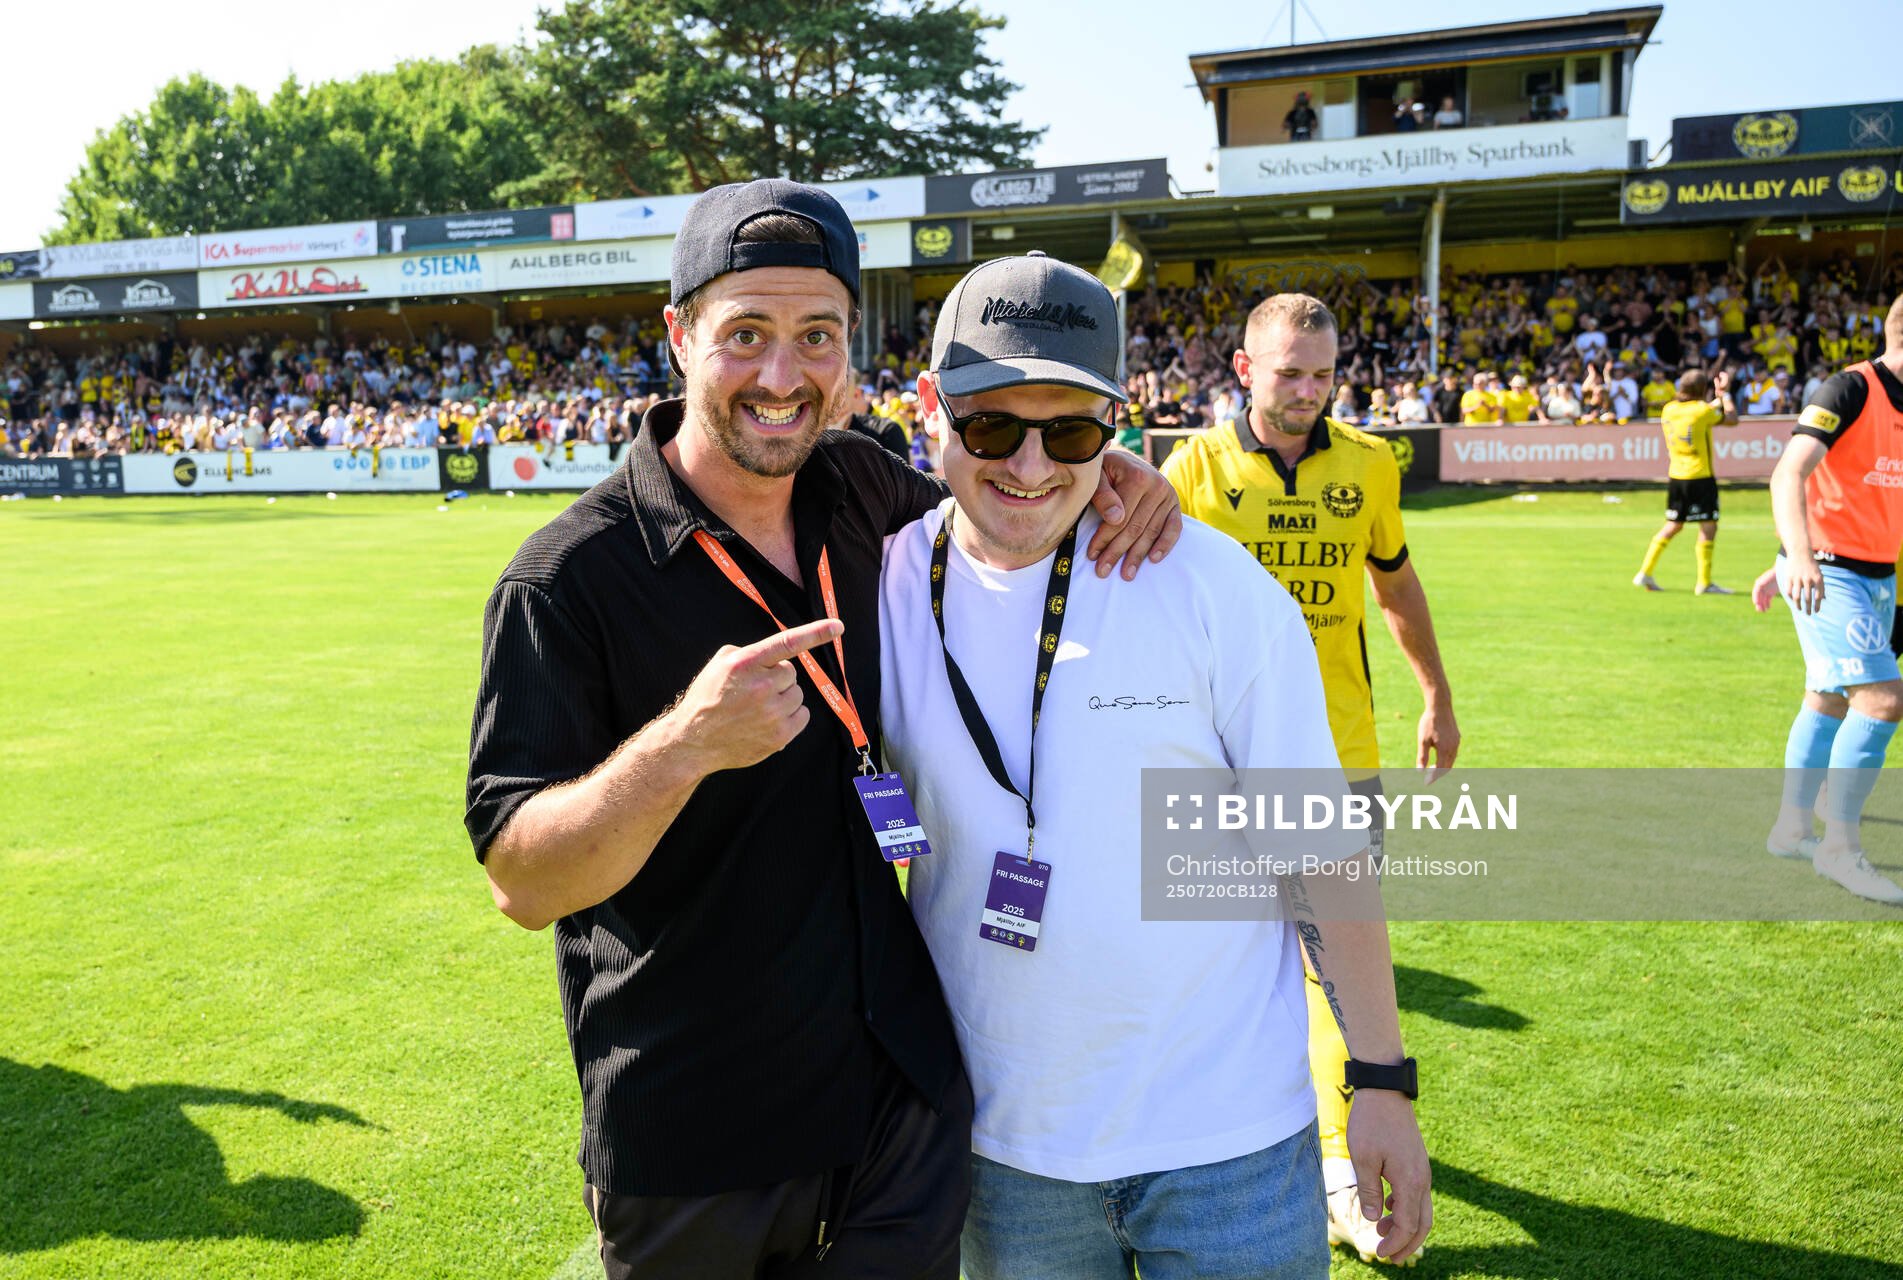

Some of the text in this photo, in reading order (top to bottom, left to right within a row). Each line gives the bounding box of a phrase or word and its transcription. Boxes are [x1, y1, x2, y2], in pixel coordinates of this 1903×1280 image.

[1257, 136, 1576, 180] Sölvesborg-Mjällby Sparbank
[1677, 176, 1831, 204] MJÄLLBY AIF
[205, 242, 230, 261] ICA
[509, 249, 637, 271] AHLBERG BIL
[419, 253, 481, 277] STENA
[1454, 435, 1614, 464] Välkommen
[1620, 435, 1659, 460] till
[400, 455, 430, 470] EBP
[1268, 498, 1316, 508] Sölvesborg
[1268, 513, 1316, 529] MAXI
[863, 787, 904, 800] FRI PASSAGE
[886, 818, 906, 829] 2025
[995, 868, 1045, 888] FRI PASSAGE
[1001, 903, 1025, 917] 2025
[996, 916, 1016, 927] Mjällby
